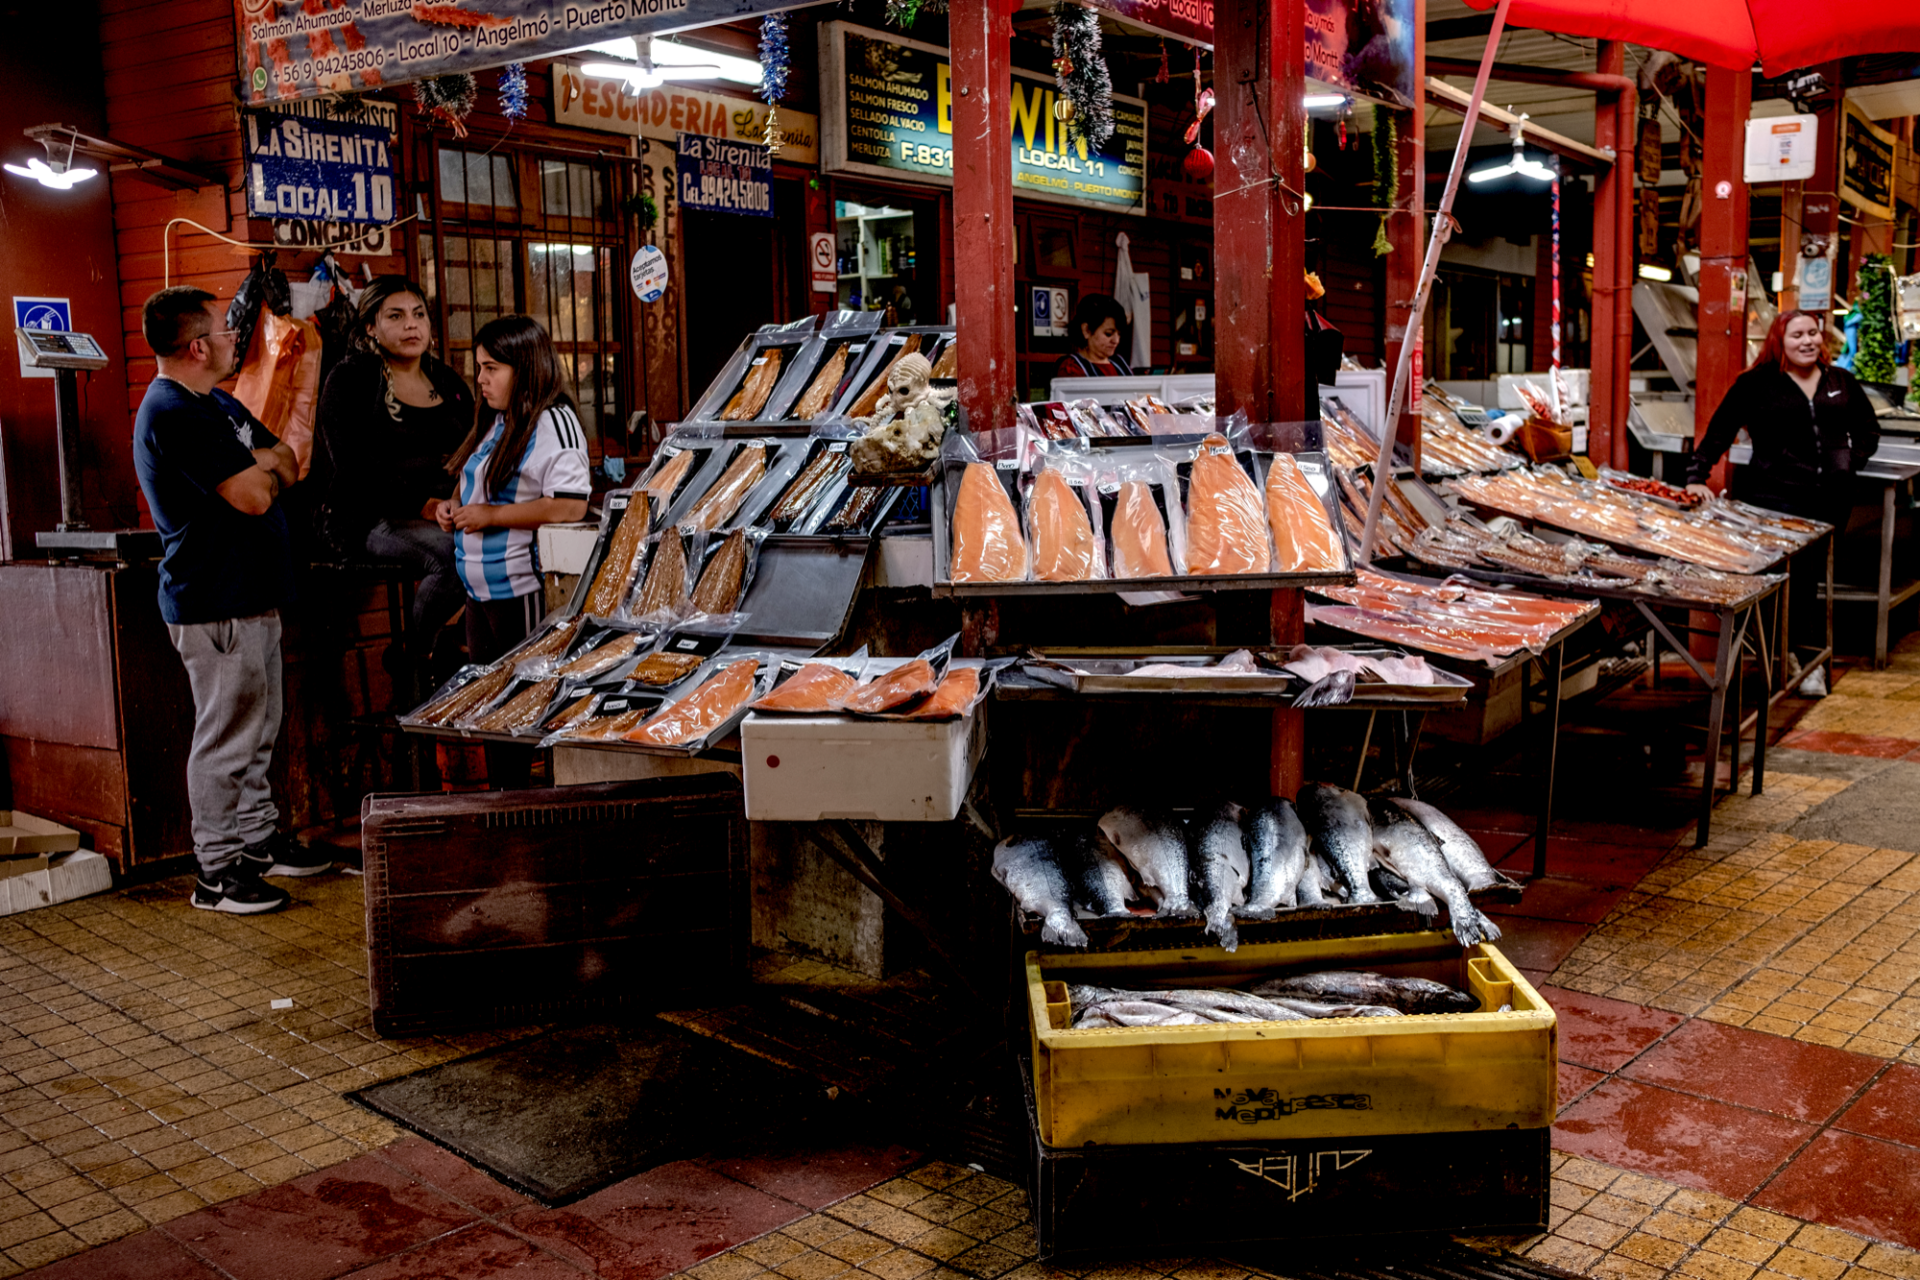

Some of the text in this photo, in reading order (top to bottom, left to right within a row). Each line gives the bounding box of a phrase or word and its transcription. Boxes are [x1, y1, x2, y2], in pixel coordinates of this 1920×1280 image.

[251, 20, 292, 40] Salmón
[295, 9, 352, 32] Ahumado
[364, 0, 412, 18] Merluza
[273, 70, 280, 82] +
[283, 66, 300, 83] 56
[303, 62, 312, 79] 9
[316, 48, 384, 77] 94245806
[399, 35, 438, 61] Local
[443, 34, 460, 54] 10
[476, 13, 548, 47] Angelmó
[566, 4, 626, 29] Puerto
[1313, 40, 1338, 69] Montt
[849, 73, 929, 101] SALMON AHUMADO
[850, 90, 919, 115] SALMON FRESCO
[850, 107, 889, 125] SELLADO
[851, 125, 896, 143] CENTOLLA
[678, 133, 772, 169] La Sirenita
[851, 142, 891, 158] MERLUZA
[1019, 147, 1104, 178] LOCAL 11
[1017, 172, 1069, 190] ANGELMÓ
[1074, 181, 1112, 197] PUERTO
[633, 254, 662, 274] Aceptamos
[633, 266, 655, 281] tarjetas
